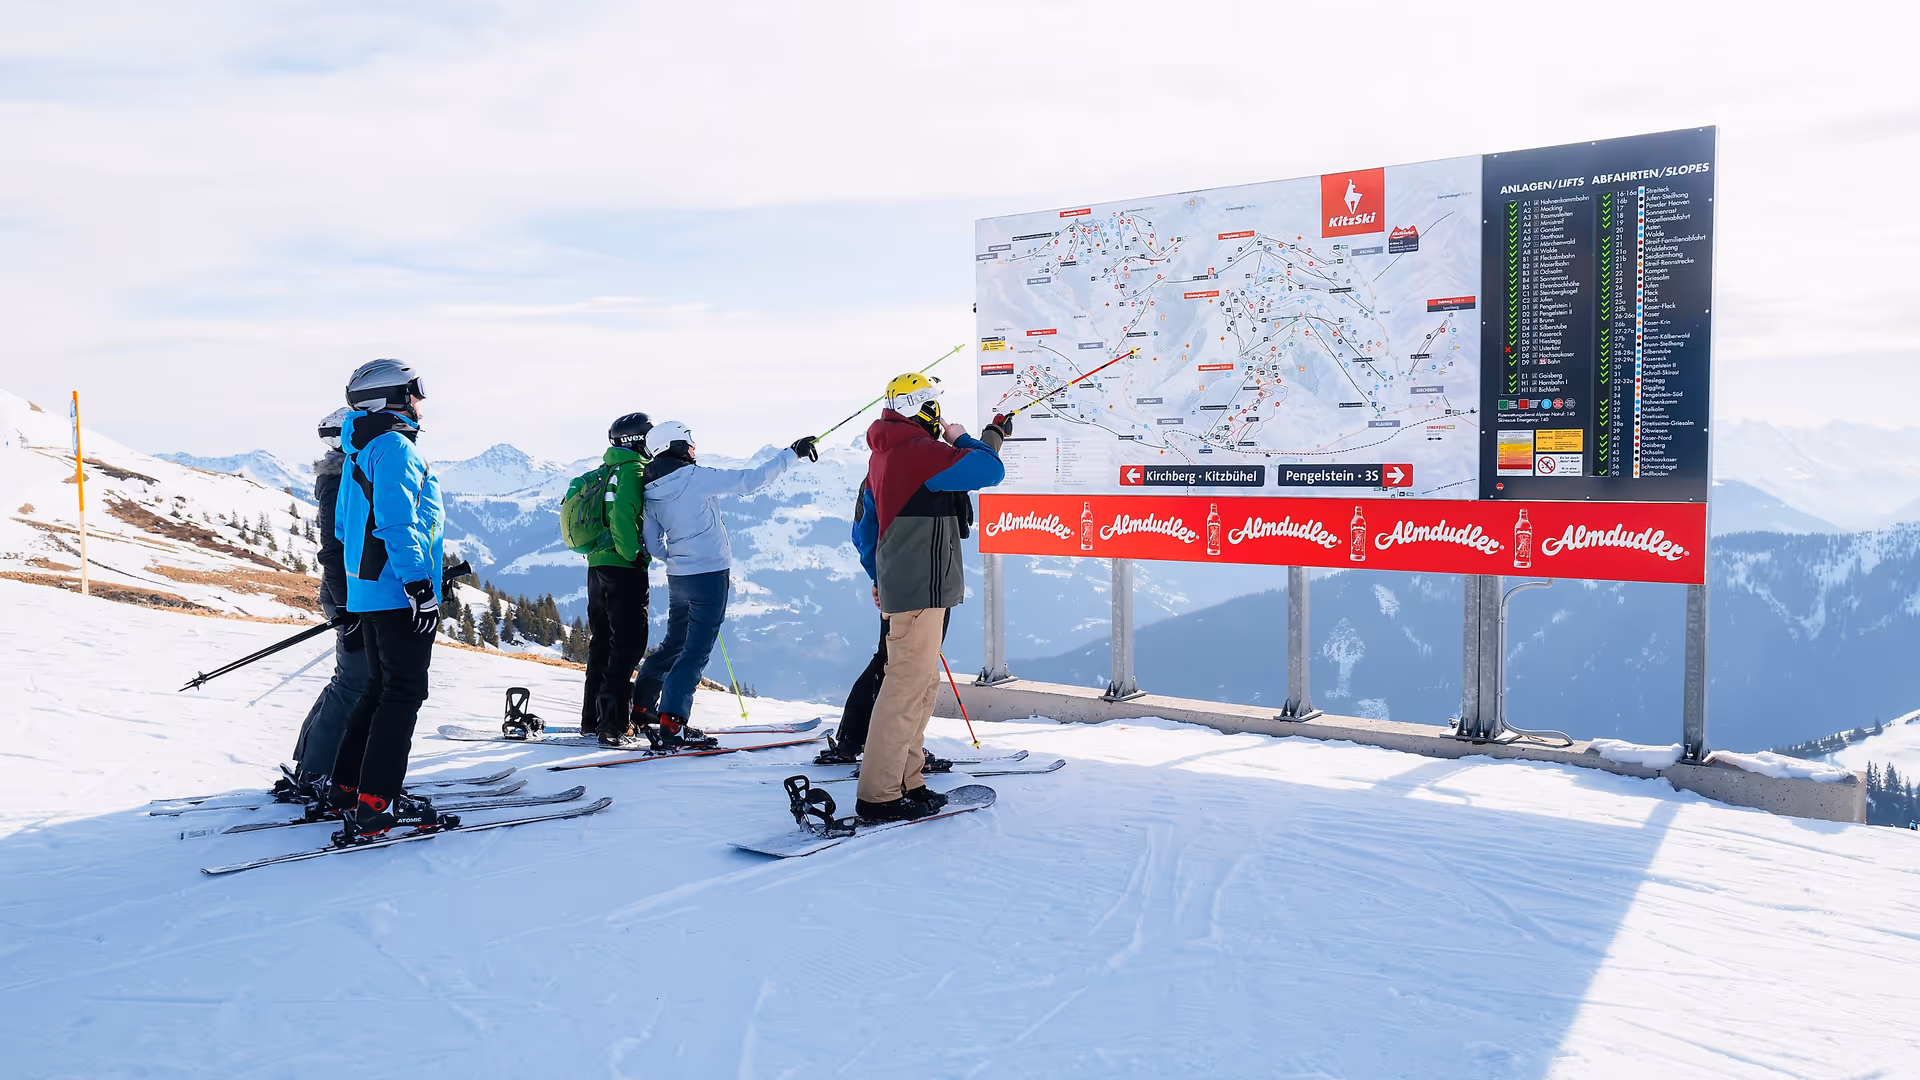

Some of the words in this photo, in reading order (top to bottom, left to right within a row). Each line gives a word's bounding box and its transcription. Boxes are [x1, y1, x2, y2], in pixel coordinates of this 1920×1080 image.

[1592, 162, 1710, 185] ABFAHRTEN/SLOPES
[1500, 177, 1585, 195] ANLAGEN/LIFTS
[1328, 212, 1376, 228] KitzSki
[621, 434, 645, 443] uvex
[1146, 471, 1195, 484] Kirchberg
[1205, 469, 1257, 482] Kitzbühel
[1286, 470, 1354, 484] Pengelstein
[1365, 471, 1379, 481] 3S
[986, 510, 1072, 540] Almdudler
[1100, 513, 1196, 544] Almdudler
[1228, 515, 1338, 548] Almdudler
[1374, 519, 1500, 555] Almdudler
[1542, 523, 1684, 561] Almdudler
